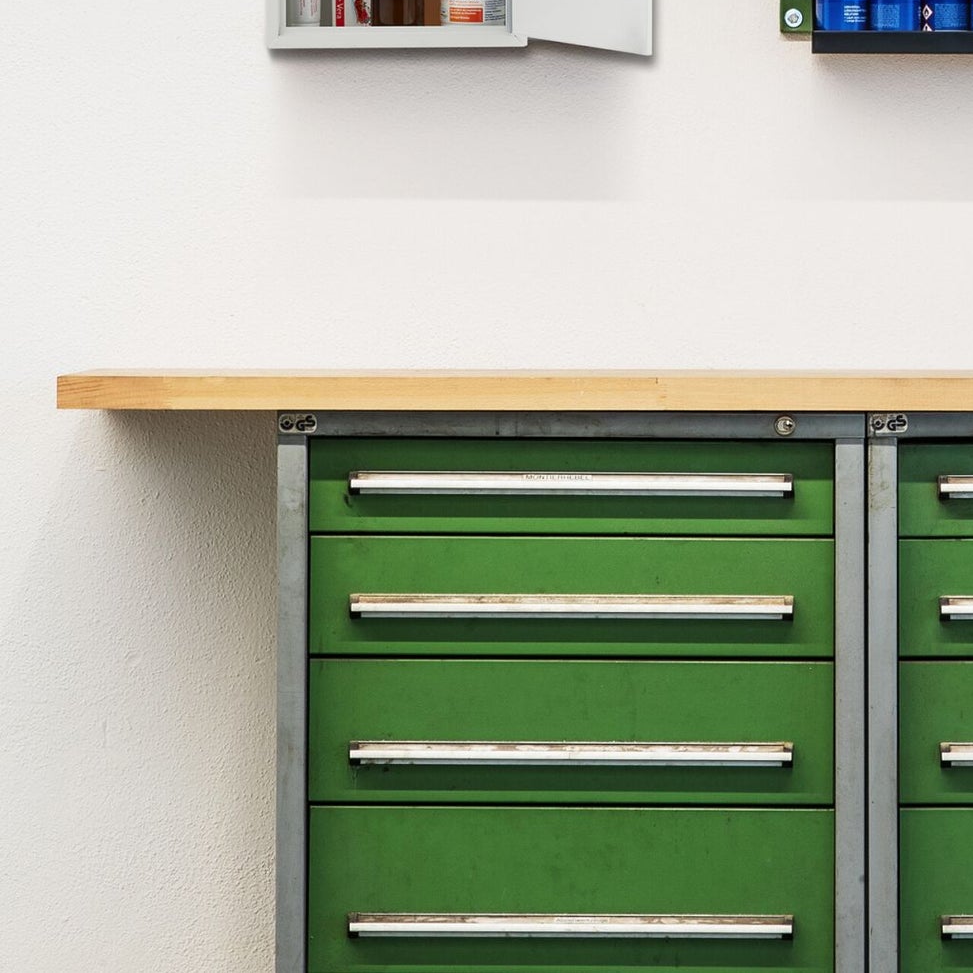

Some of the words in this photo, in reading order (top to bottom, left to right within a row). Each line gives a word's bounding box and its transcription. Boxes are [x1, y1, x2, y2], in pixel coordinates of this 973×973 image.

[336, 2, 344, 19] Vera
[296, 414, 315, 431] GS
[887, 414, 907, 431] GS
